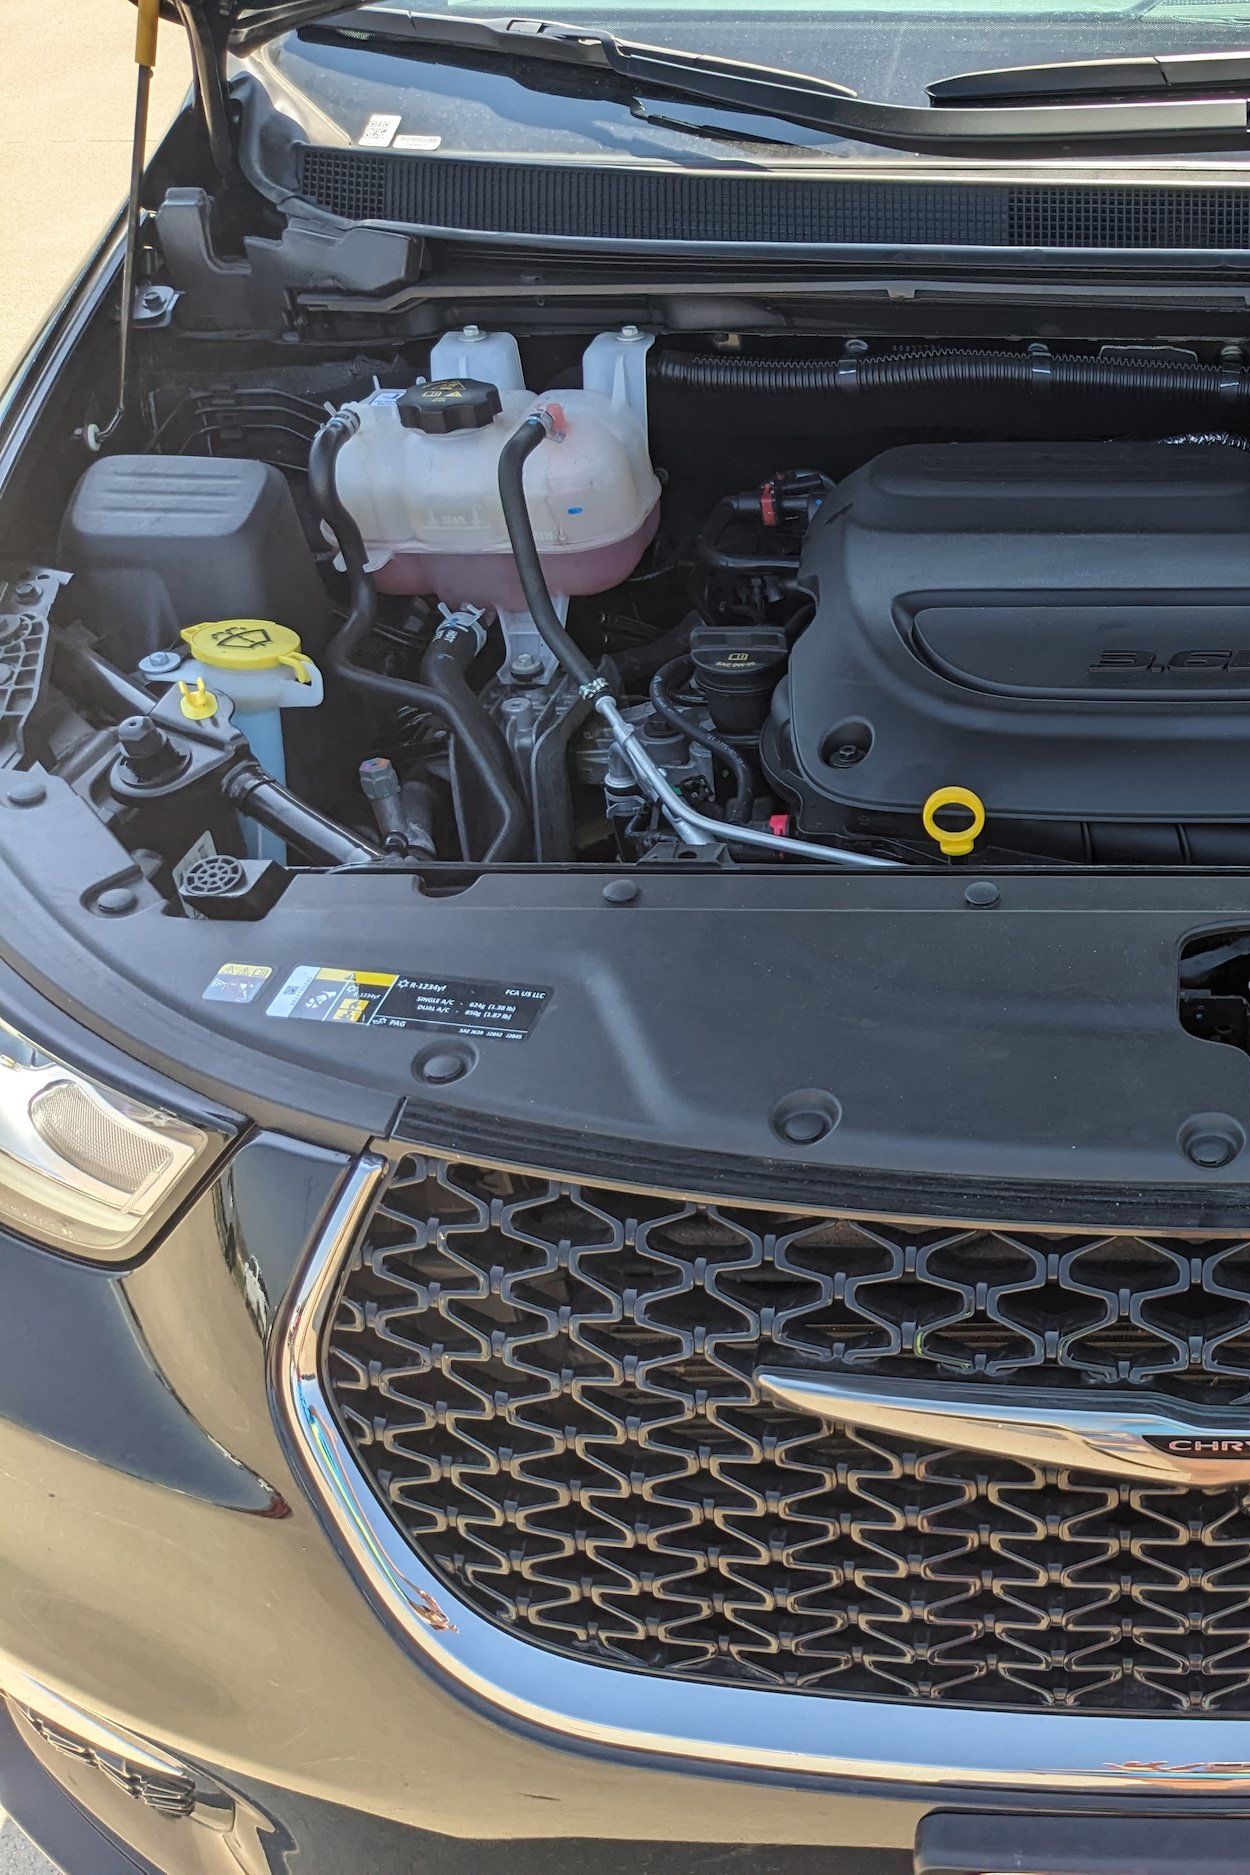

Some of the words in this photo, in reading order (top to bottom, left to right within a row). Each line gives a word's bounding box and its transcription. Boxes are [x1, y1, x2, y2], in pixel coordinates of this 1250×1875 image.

[410, 981, 448, 993] R-1234yf
[505, 989, 520, 997] FCA
[416, 996, 441, 1004] SINGLE
[506, 1005, 517, 1013] lb)
[417, 1004, 436, 1012] DUAL
[436, 1006, 451, 1014] A/C
[501, 1013, 513, 1021] lb)
[389, 1019, 407, 1028] PAG
